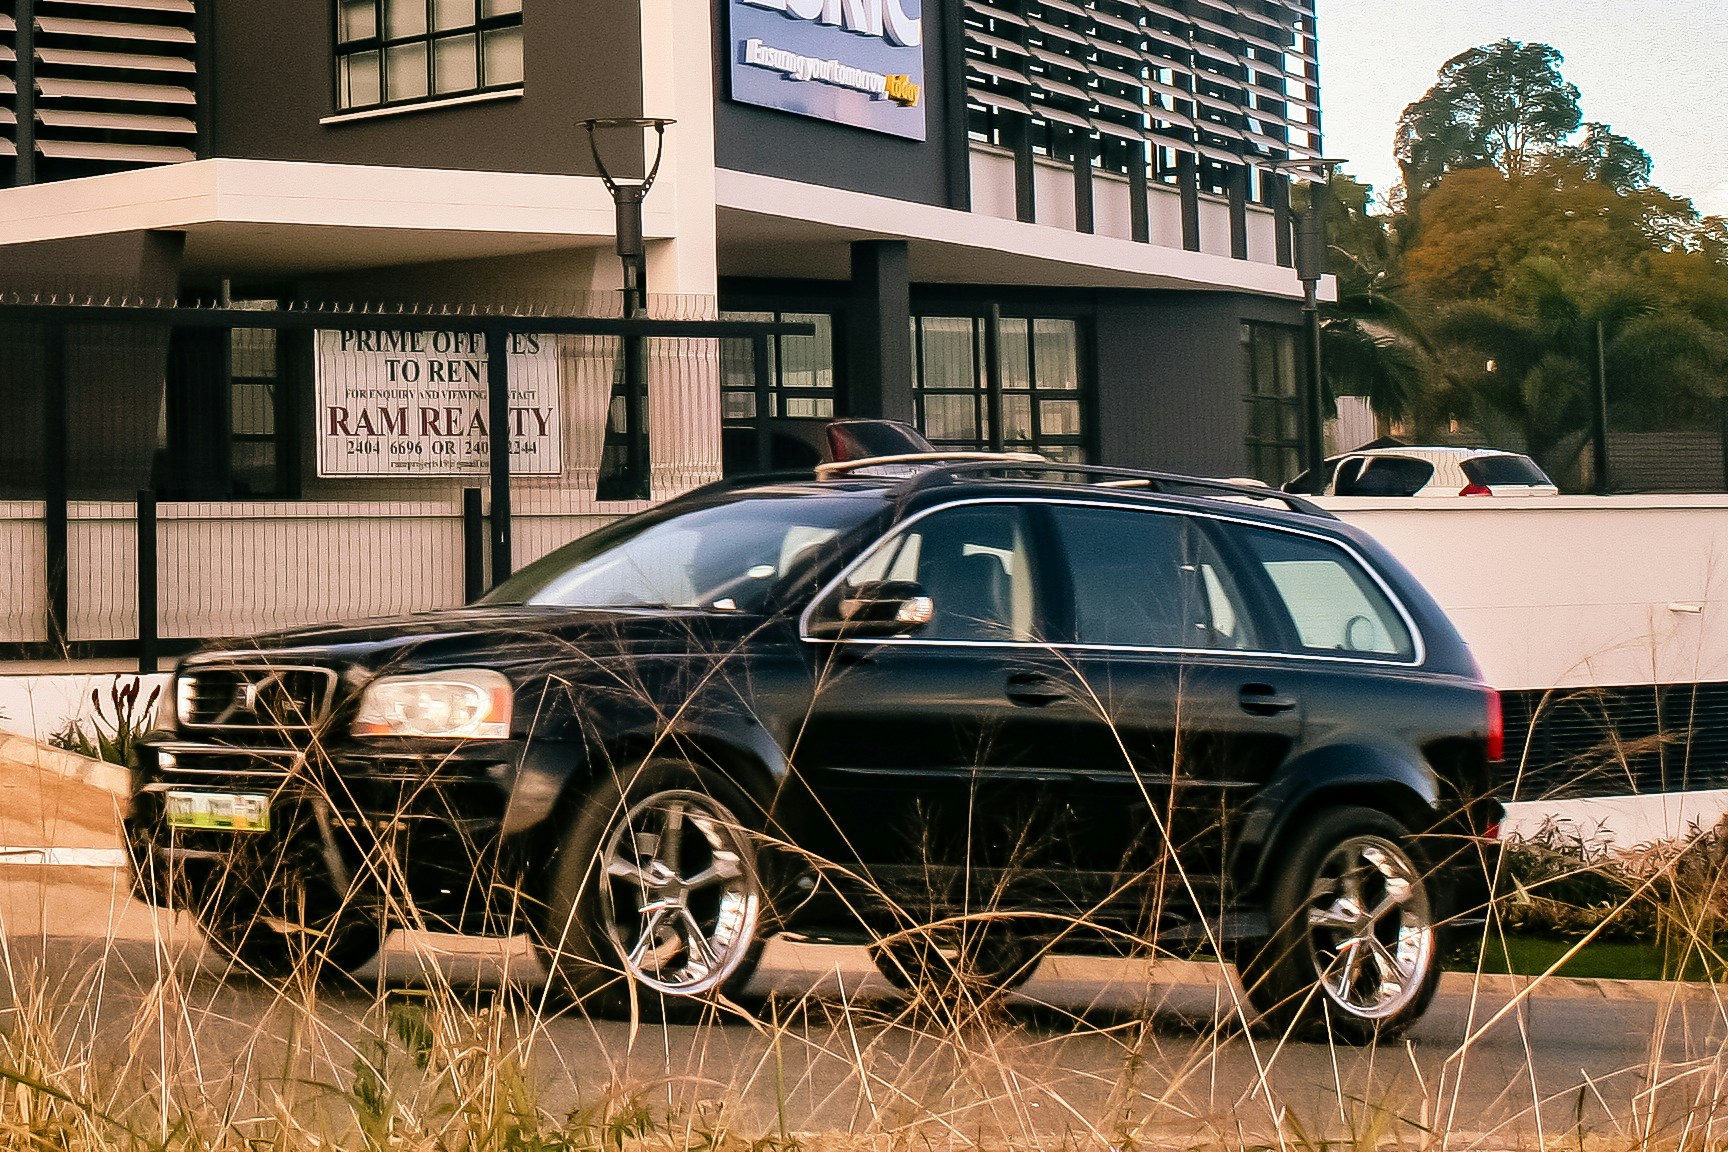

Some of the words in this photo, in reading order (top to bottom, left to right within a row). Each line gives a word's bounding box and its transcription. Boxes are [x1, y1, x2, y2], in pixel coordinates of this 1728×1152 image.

[340, 329, 425, 353] PRIME
[432, 330, 540, 355] OFFES
[385, 359, 420, 383] TO
[327, 406, 410, 437] RAM
[420, 406, 554, 437] REATY
[346, 440, 380, 455] 2404
[390, 440, 423, 455] 6696
[431, 440, 457, 455] OR
